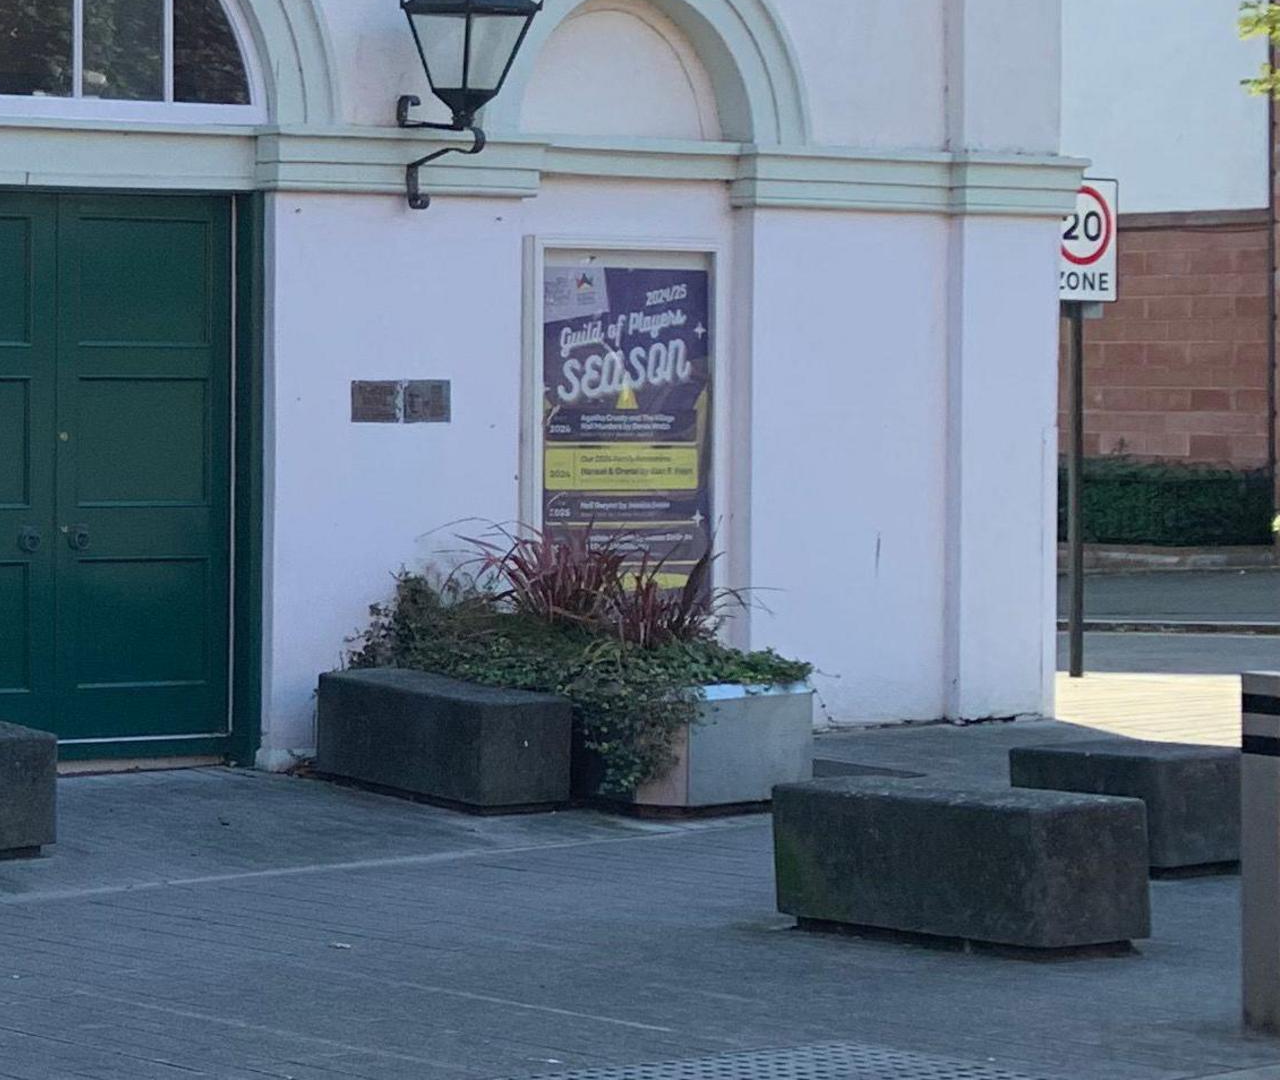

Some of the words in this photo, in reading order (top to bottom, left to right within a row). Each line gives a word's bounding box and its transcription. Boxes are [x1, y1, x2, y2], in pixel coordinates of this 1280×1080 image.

[1061, 210, 1102, 242] 20
[646, 283, 688, 307] 2024/25
[559, 320, 605, 358] Guild
[607, 314, 626, 348] of
[628, 308, 688, 338] Players
